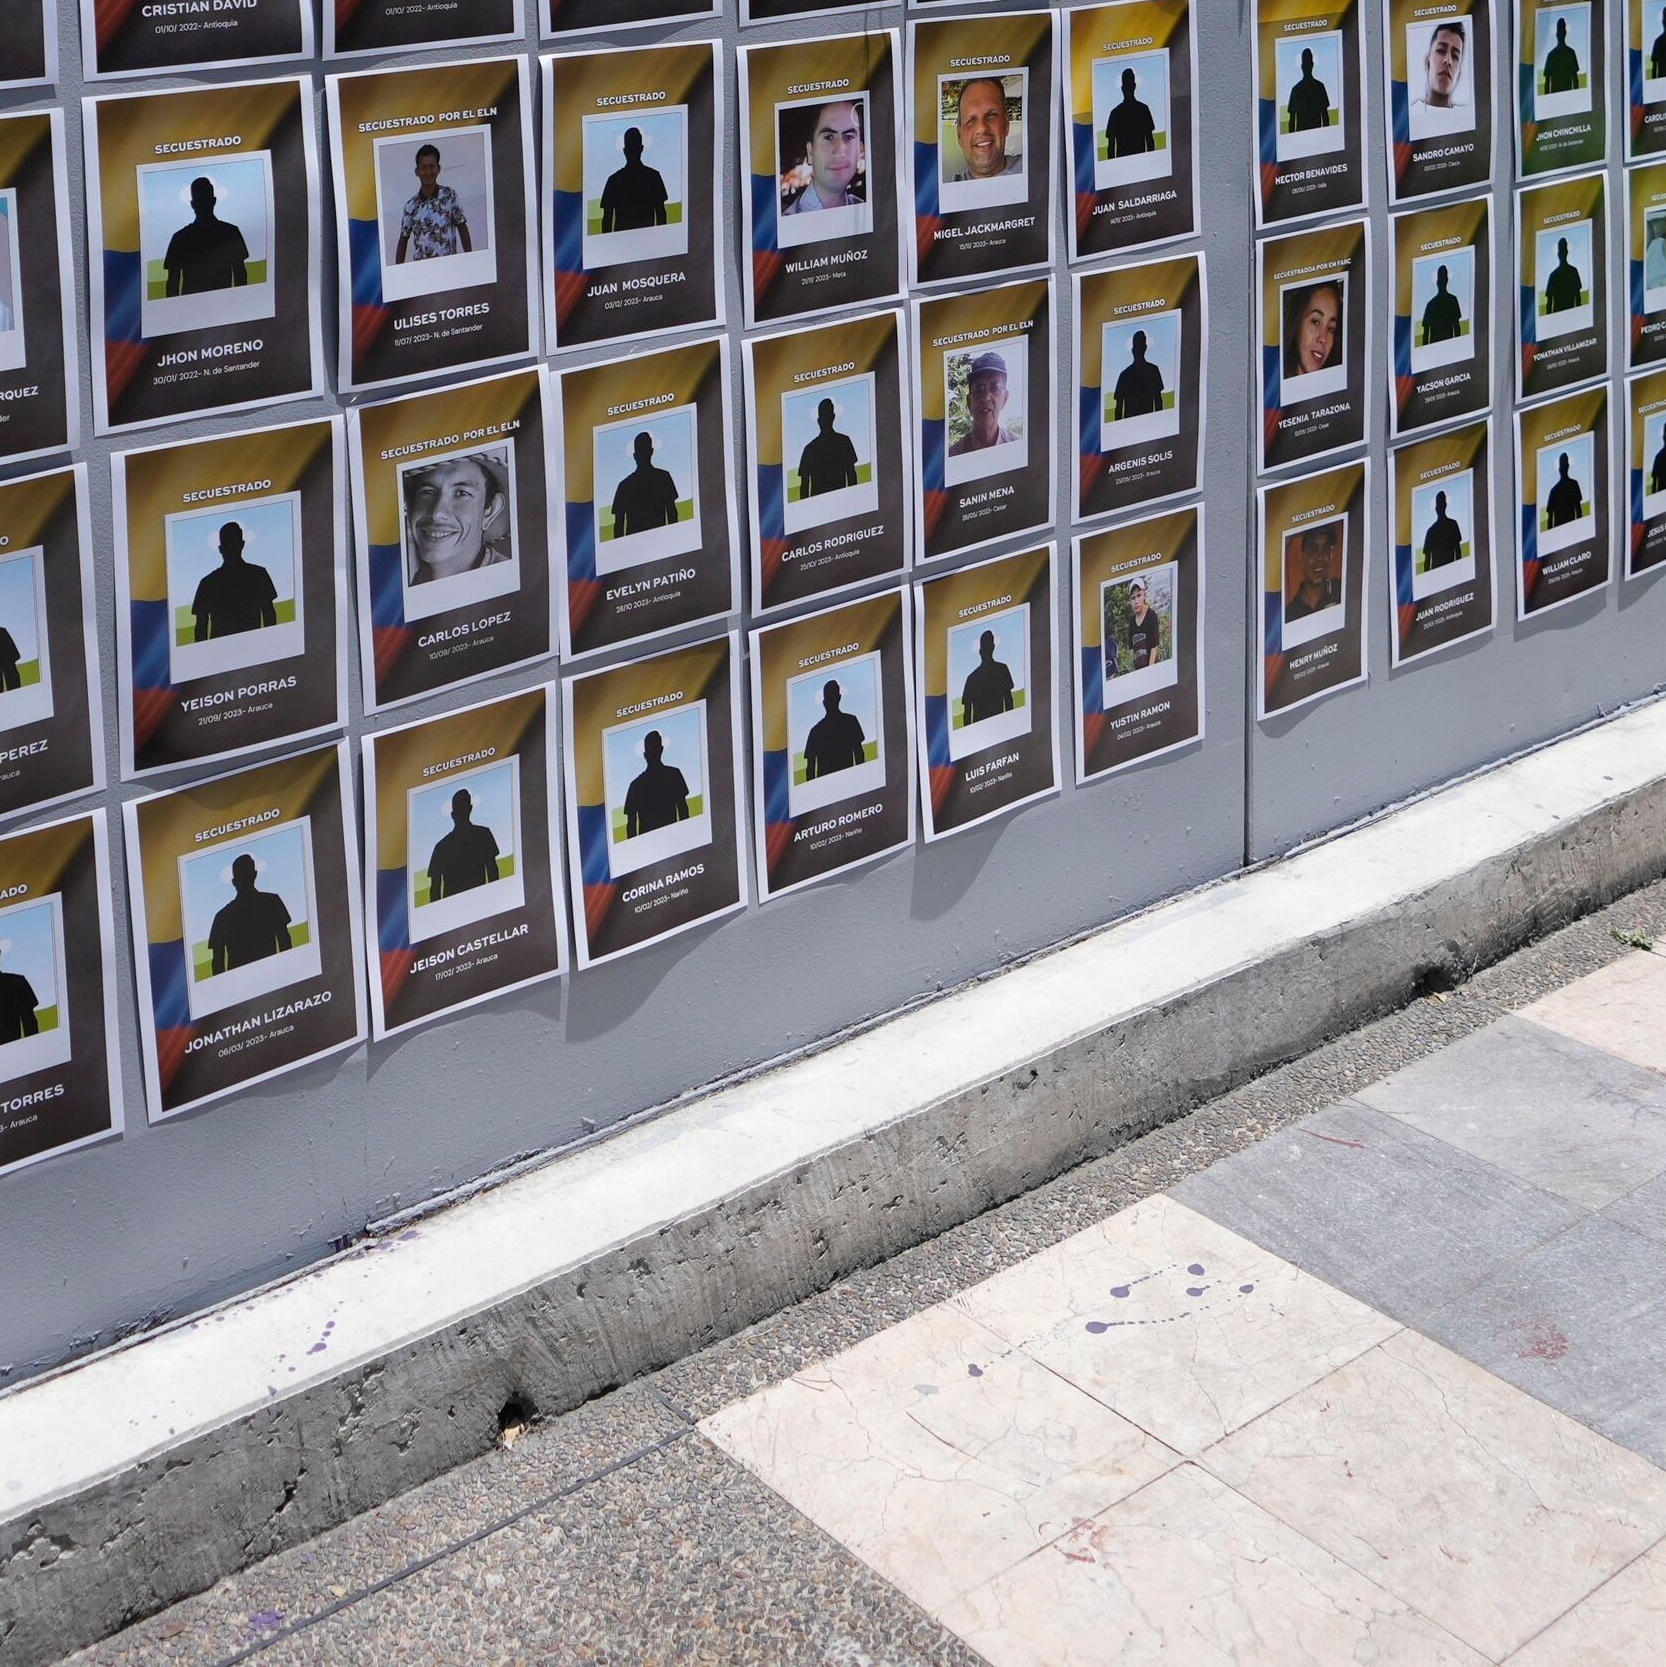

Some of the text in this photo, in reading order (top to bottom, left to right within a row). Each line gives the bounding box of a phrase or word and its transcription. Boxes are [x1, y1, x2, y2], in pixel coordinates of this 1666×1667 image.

[142, 0, 210, 17] CRISTIAN
[155, 19, 238, 34] 01/10/ 2022- Antioquia
[1092, 190, 1177, 215] JUAN SALDARRIAGA
[934, 216, 1035, 240] MIGEL JACKMARGRET
[785, 249, 868, 273] WILLIAM MUÑOZ
[587, 271, 686, 297] JUAN MOSQUERA
[394, 302, 490, 330] ULISES TORRES
[157, 339, 263, 367] JHON MORENO
[1108, 450, 1173, 474] ARGENIS SOLIS
[959, 486, 1015, 508] SANIN MENA
[781, 525, 884, 562] CARLOS RODRIGUEZ
[606, 568, 696, 601] EVELYN PATIÑO
[418, 611, 511, 647] CARLOS LOPEZ
[181, 676, 296, 712] YEISON PORRAS
[1110, 701, 1170, 730] YUSTIN RAMON
[965, 752, 1019, 782] LUIS FARFAN
[794, 803, 883, 842] ARTURO ROMERO
[622, 863, 704, 902] CORINA RAMOS
[410, 924, 528, 974] JEISON CASTELLAR
[184, 991, 332, 1054] JONATHAN LIZARAZO
[0, 1084, 64, 1113] TORRES
